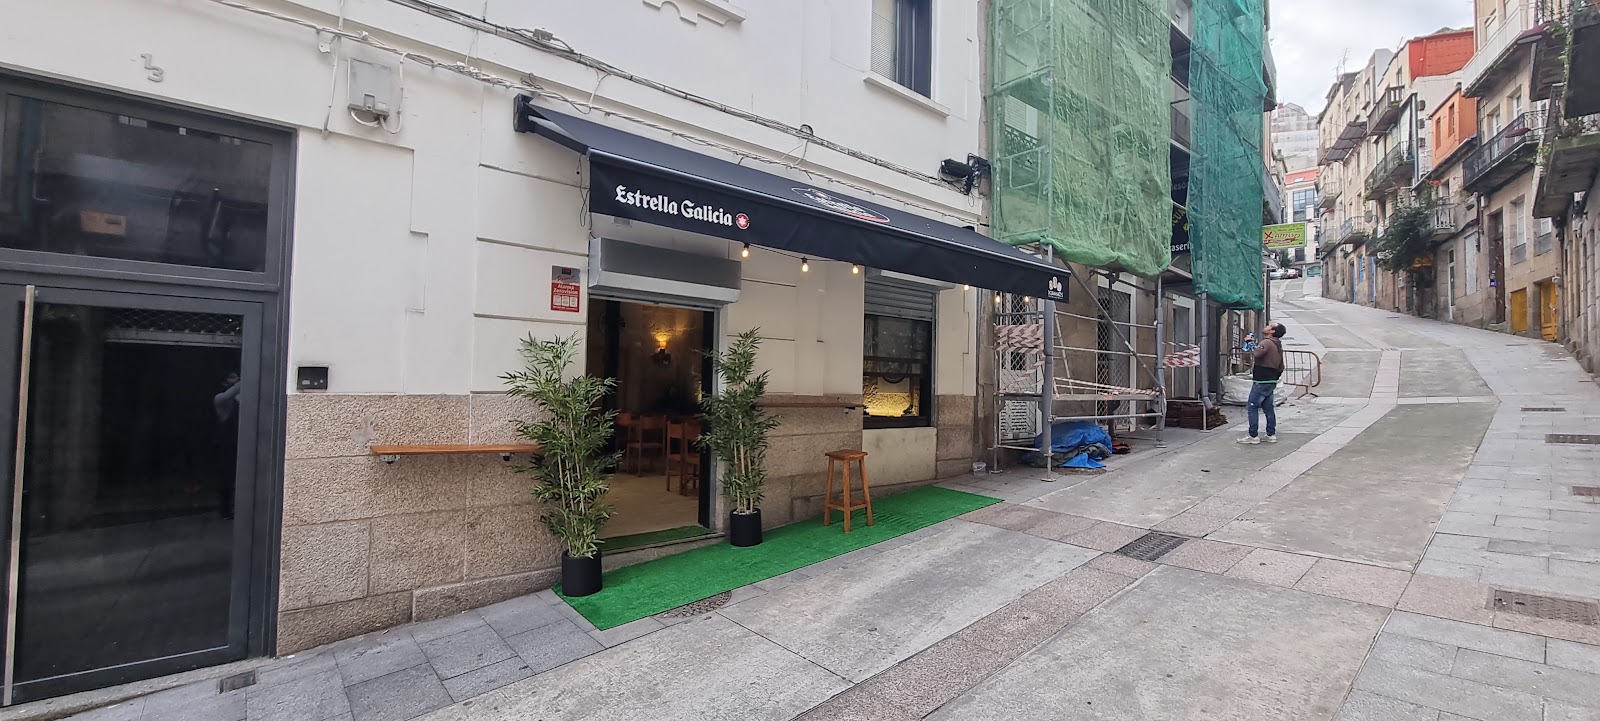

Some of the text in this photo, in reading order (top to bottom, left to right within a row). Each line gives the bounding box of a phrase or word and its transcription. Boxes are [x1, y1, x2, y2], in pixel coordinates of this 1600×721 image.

[140, 53, 164, 83] 13
[615, 184, 733, 226] Estrella Galicia
